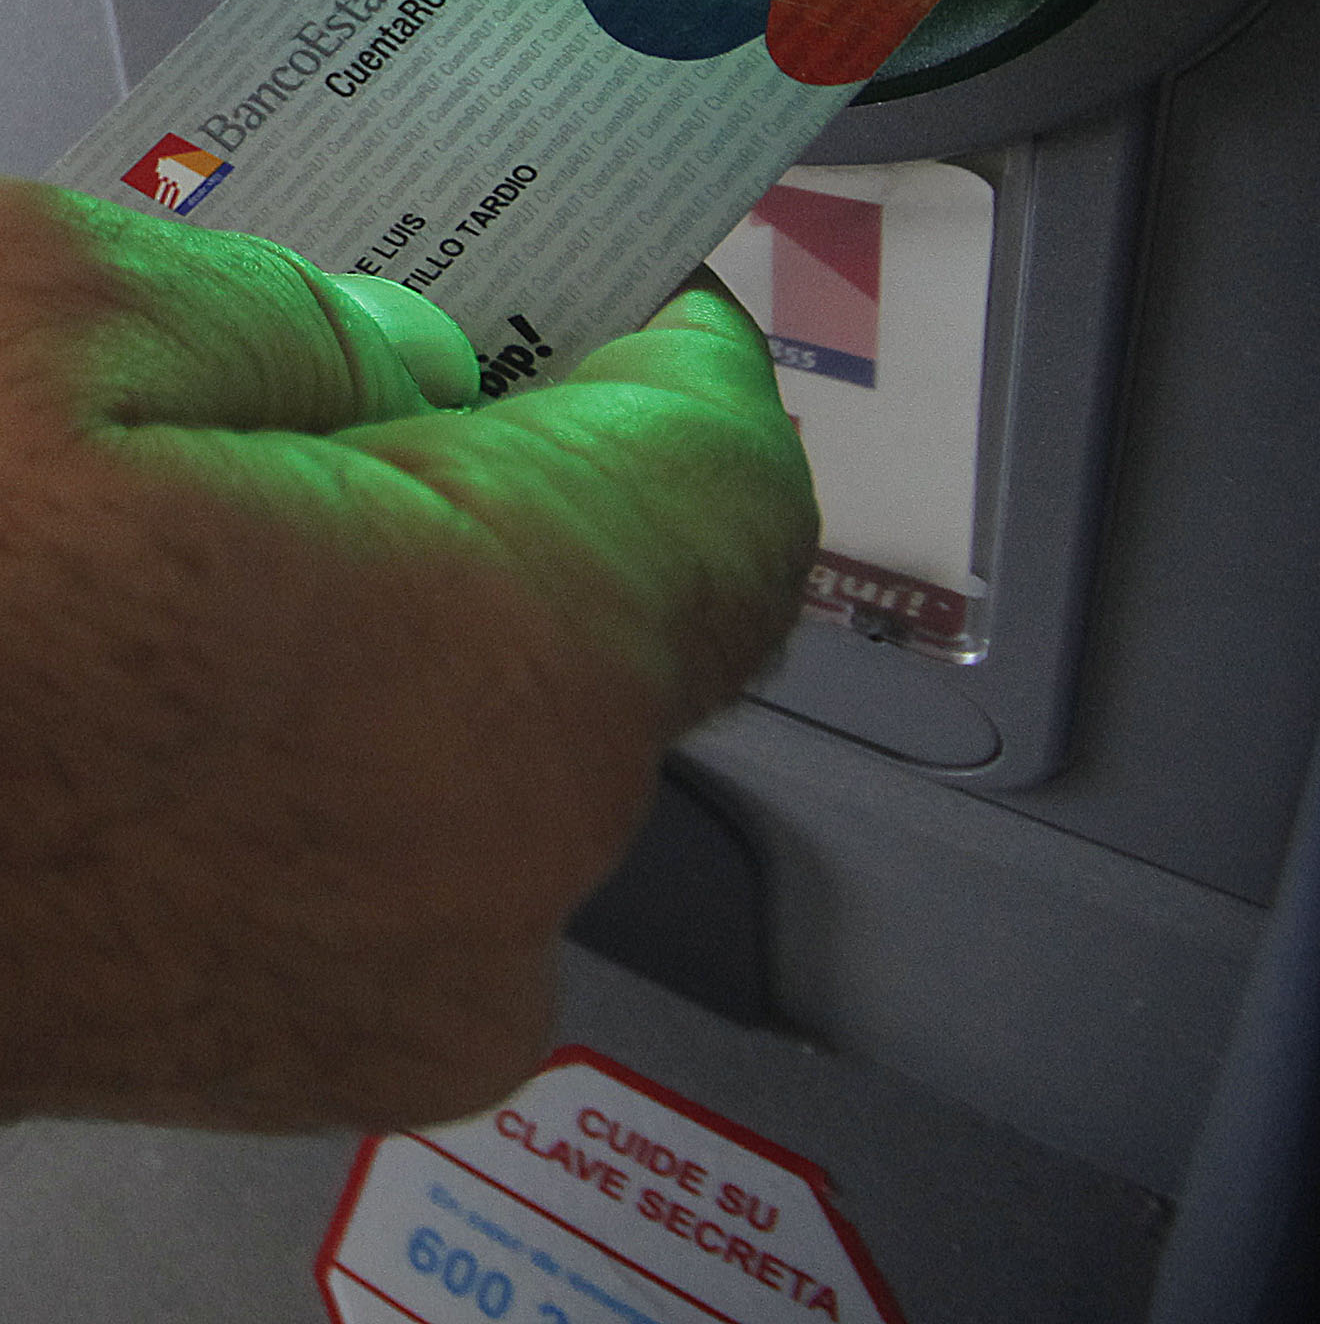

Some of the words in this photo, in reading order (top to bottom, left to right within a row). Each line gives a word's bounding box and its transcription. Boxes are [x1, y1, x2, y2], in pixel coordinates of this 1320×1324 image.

[346, 256, 382, 277] E
[371, 213, 427, 260] LUIS
[401, 237, 465, 295] TILLO
[455, 164, 539, 237] TARDIO
[493, 1108, 631, 1201] CLAVE
[636, 1188, 841, 1322] SECRETA
[576, 1107, 709, 1198] CUIDE
[716, 1181, 780, 1234] SU
[405, 1225, 515, 1320] 600
